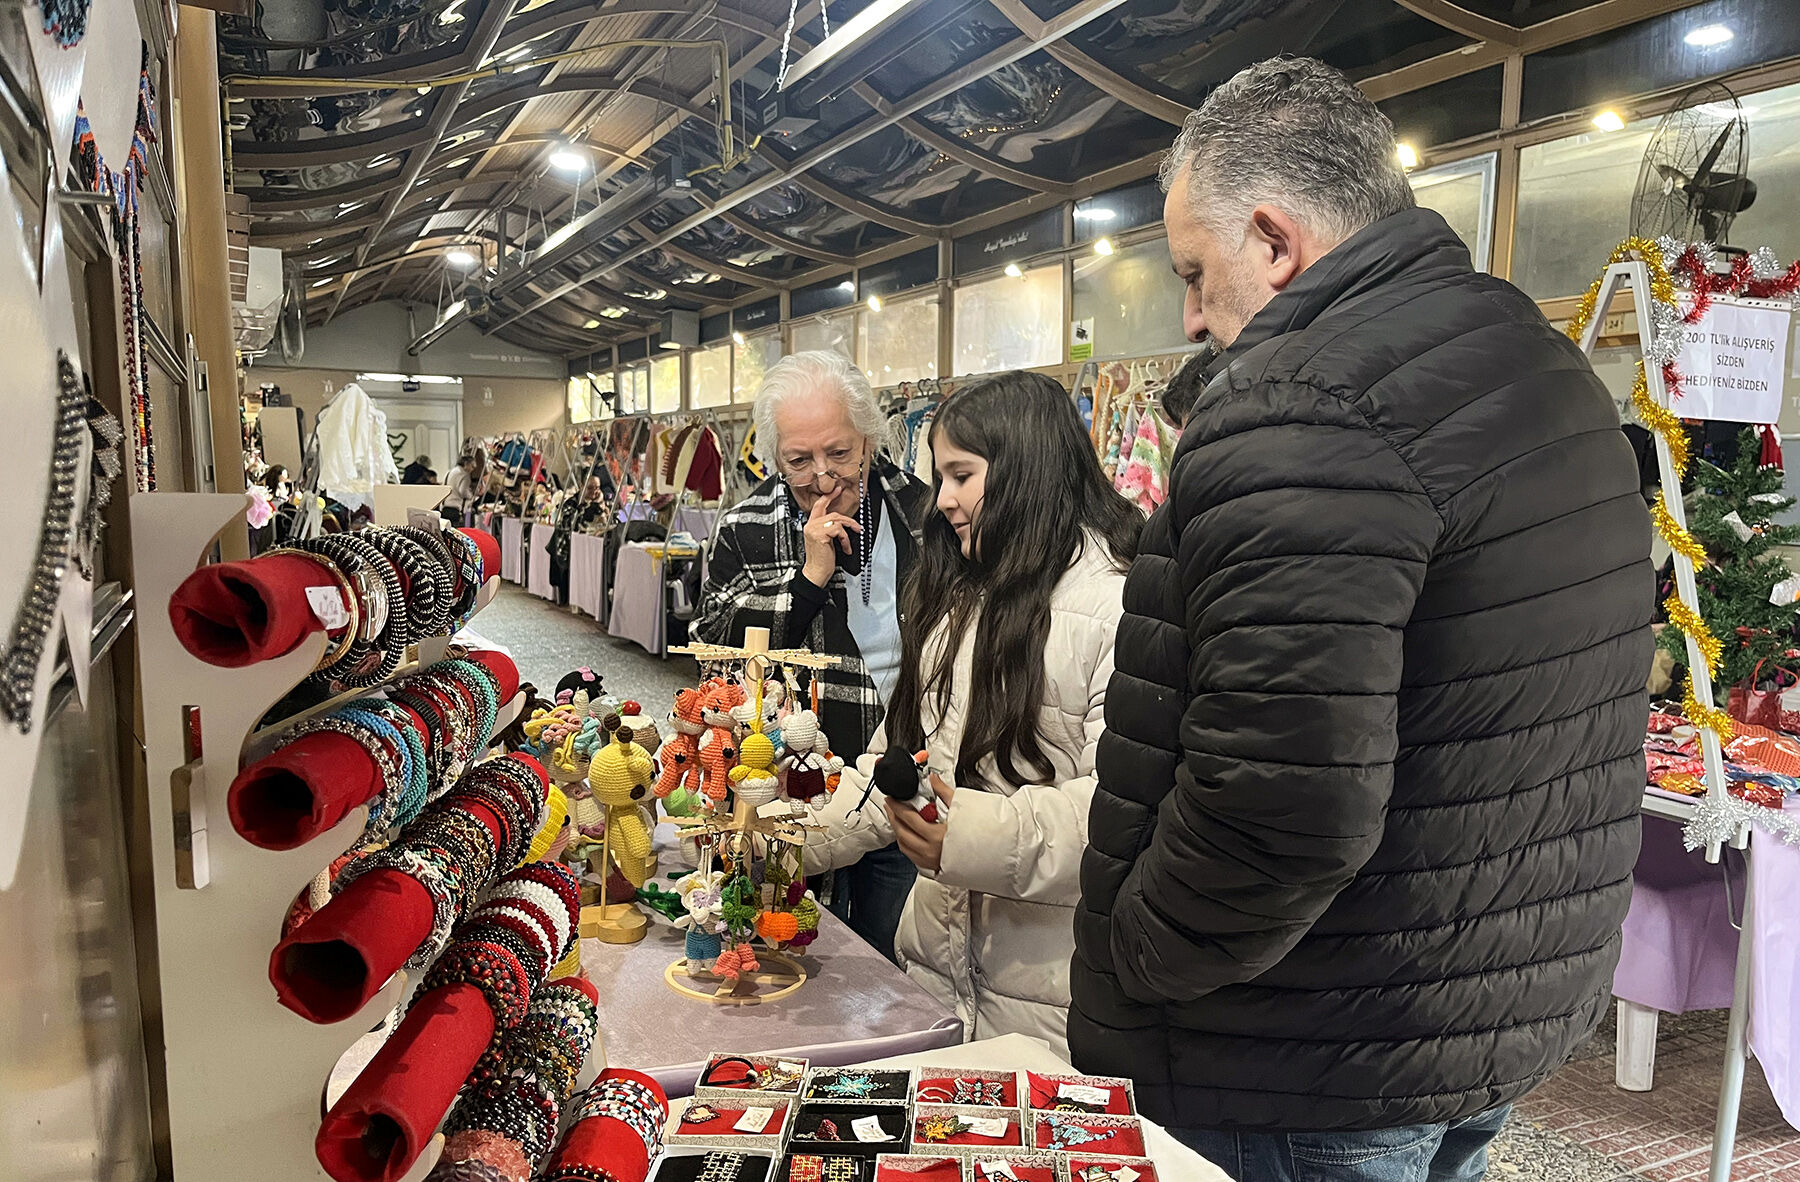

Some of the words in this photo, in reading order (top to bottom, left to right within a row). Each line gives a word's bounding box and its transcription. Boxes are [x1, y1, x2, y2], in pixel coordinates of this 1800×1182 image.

[1685, 332, 1706, 343] 200
[1732, 336, 1775, 353] ALIŞVERİŞ
[1716, 353, 1745, 368] SİZDEN
[1685, 374, 1735, 389] HEDİYENİZ
[1737, 377, 1768, 391] BİZDEN
